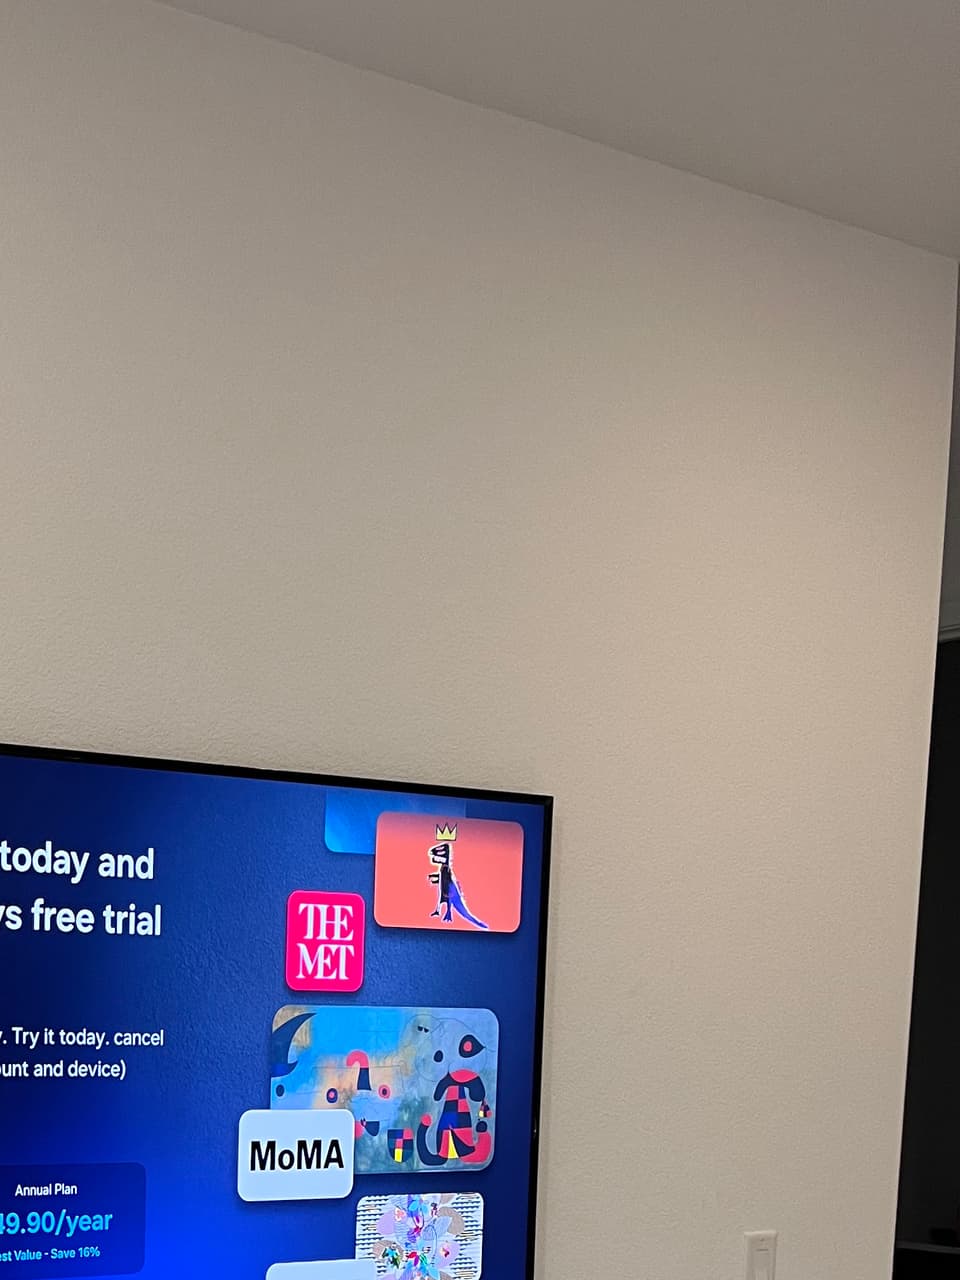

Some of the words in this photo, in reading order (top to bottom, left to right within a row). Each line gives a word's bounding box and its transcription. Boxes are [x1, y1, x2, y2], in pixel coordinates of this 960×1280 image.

[98, 847, 155, 880] and
[30, 899, 94, 933] free
[102, 904, 161, 936] trial
[298, 903, 353, 941] THE
[295, 943, 355, 980] MET
[11, 1026, 40, 1050] Try
[43, 1027, 55, 1046] it
[58, 1027, 110, 1050] today.
[113, 1029, 165, 1047] cancel
[33, 1059, 64, 1078] and
[67, 1059, 126, 1081] device)
[249, 1139, 345, 1171] MoMA
[14, 1183, 52, 1197] Annual
[54, 1182, 77, 1196] Plan
[14, 1249, 42, 1261] Value
[50, 1247, 76, 1260] Save
[78, 1245, 100, 1258] 16%
